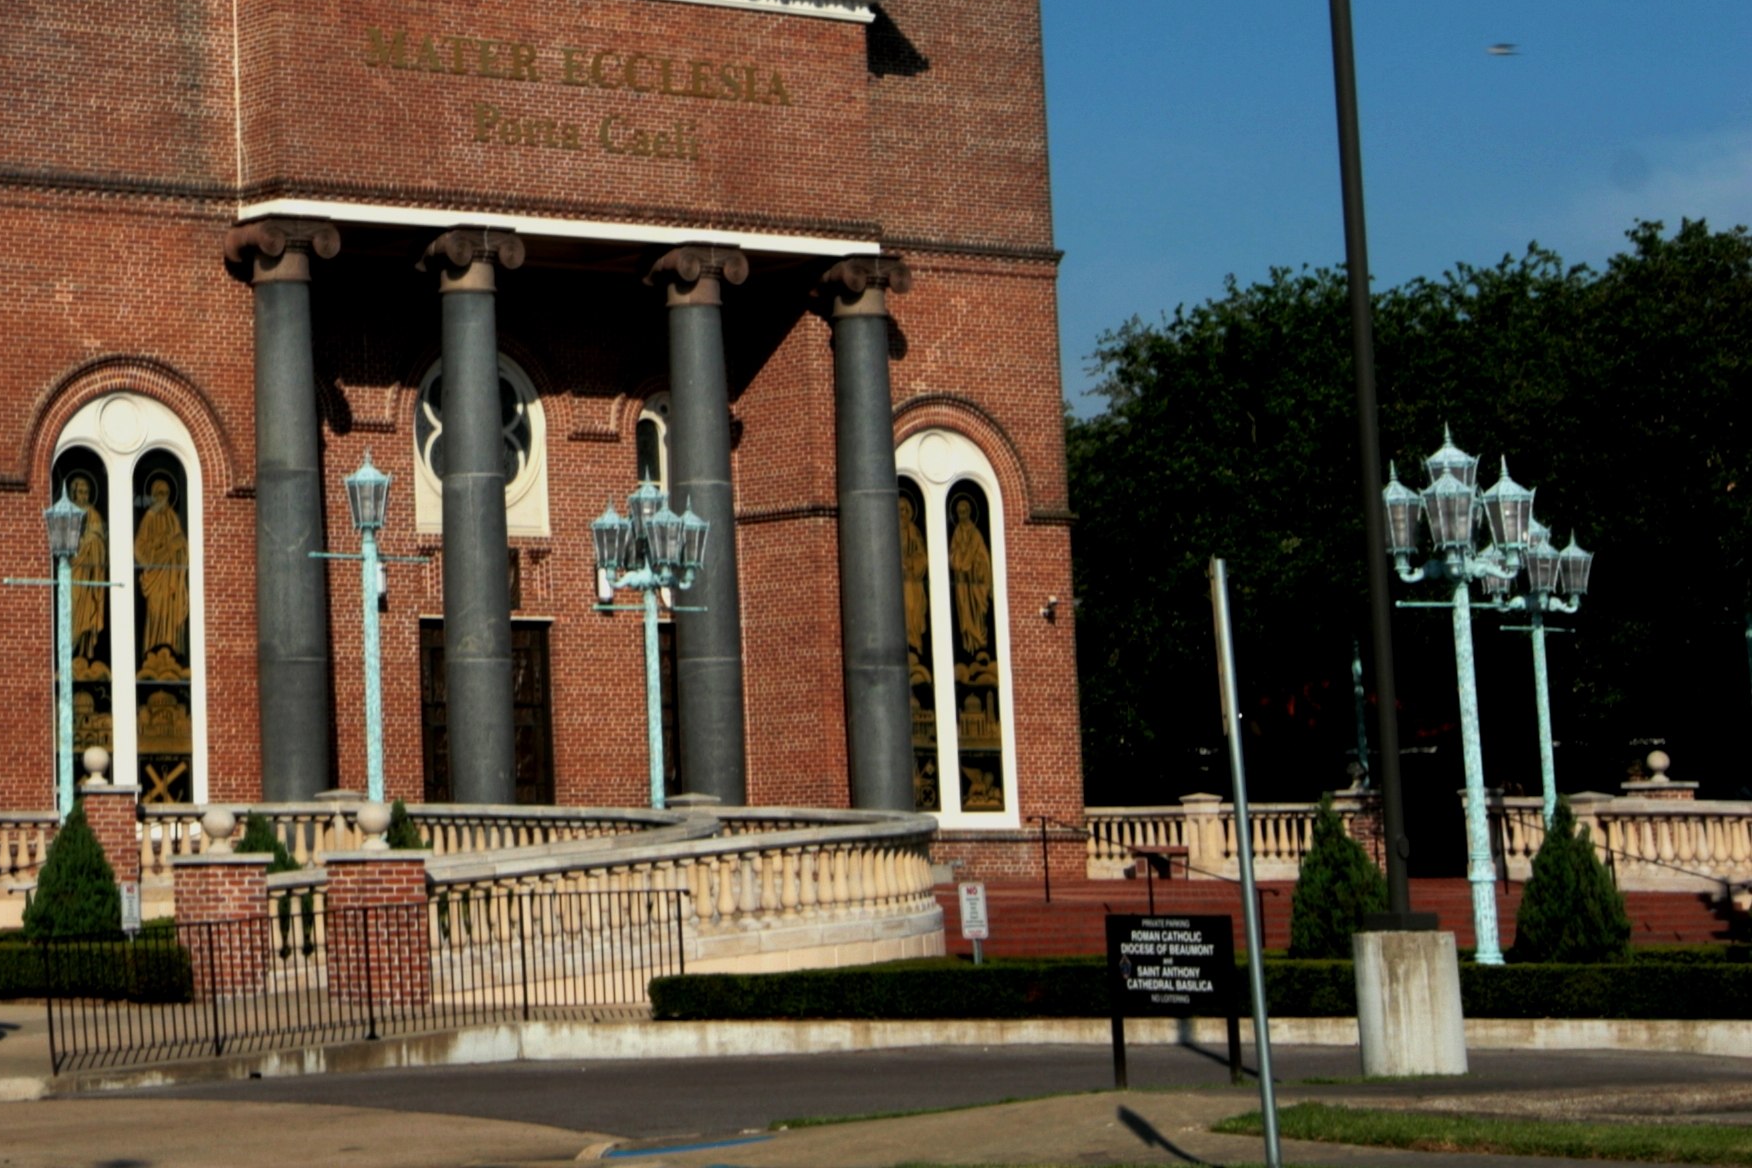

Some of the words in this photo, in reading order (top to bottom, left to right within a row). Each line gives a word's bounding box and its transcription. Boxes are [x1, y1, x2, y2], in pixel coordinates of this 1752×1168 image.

[366, 28, 541, 83] MATER
[561, 47, 793, 107] ECCLESIA
[473, 102, 583, 150] Porta
[599, 113, 700, 161] Caeli
[966, 886, 978, 896] NO
[1131, 930, 1161, 942] ROMAN
[1162, 931, 1202, 943] CATHOLIC
[1120, 942, 1155, 955] DIOCESE
[1156, 943, 1168, 955] OF
[1169, 944, 1214, 956] BEAUMONT
[1137, 965, 1161, 977] SAINT
[1162, 966, 1201, 979] ANTHONY
[1127, 978, 1174, 991] CATHEDRAL
[1176, 979, 1213, 992] BASILICA
